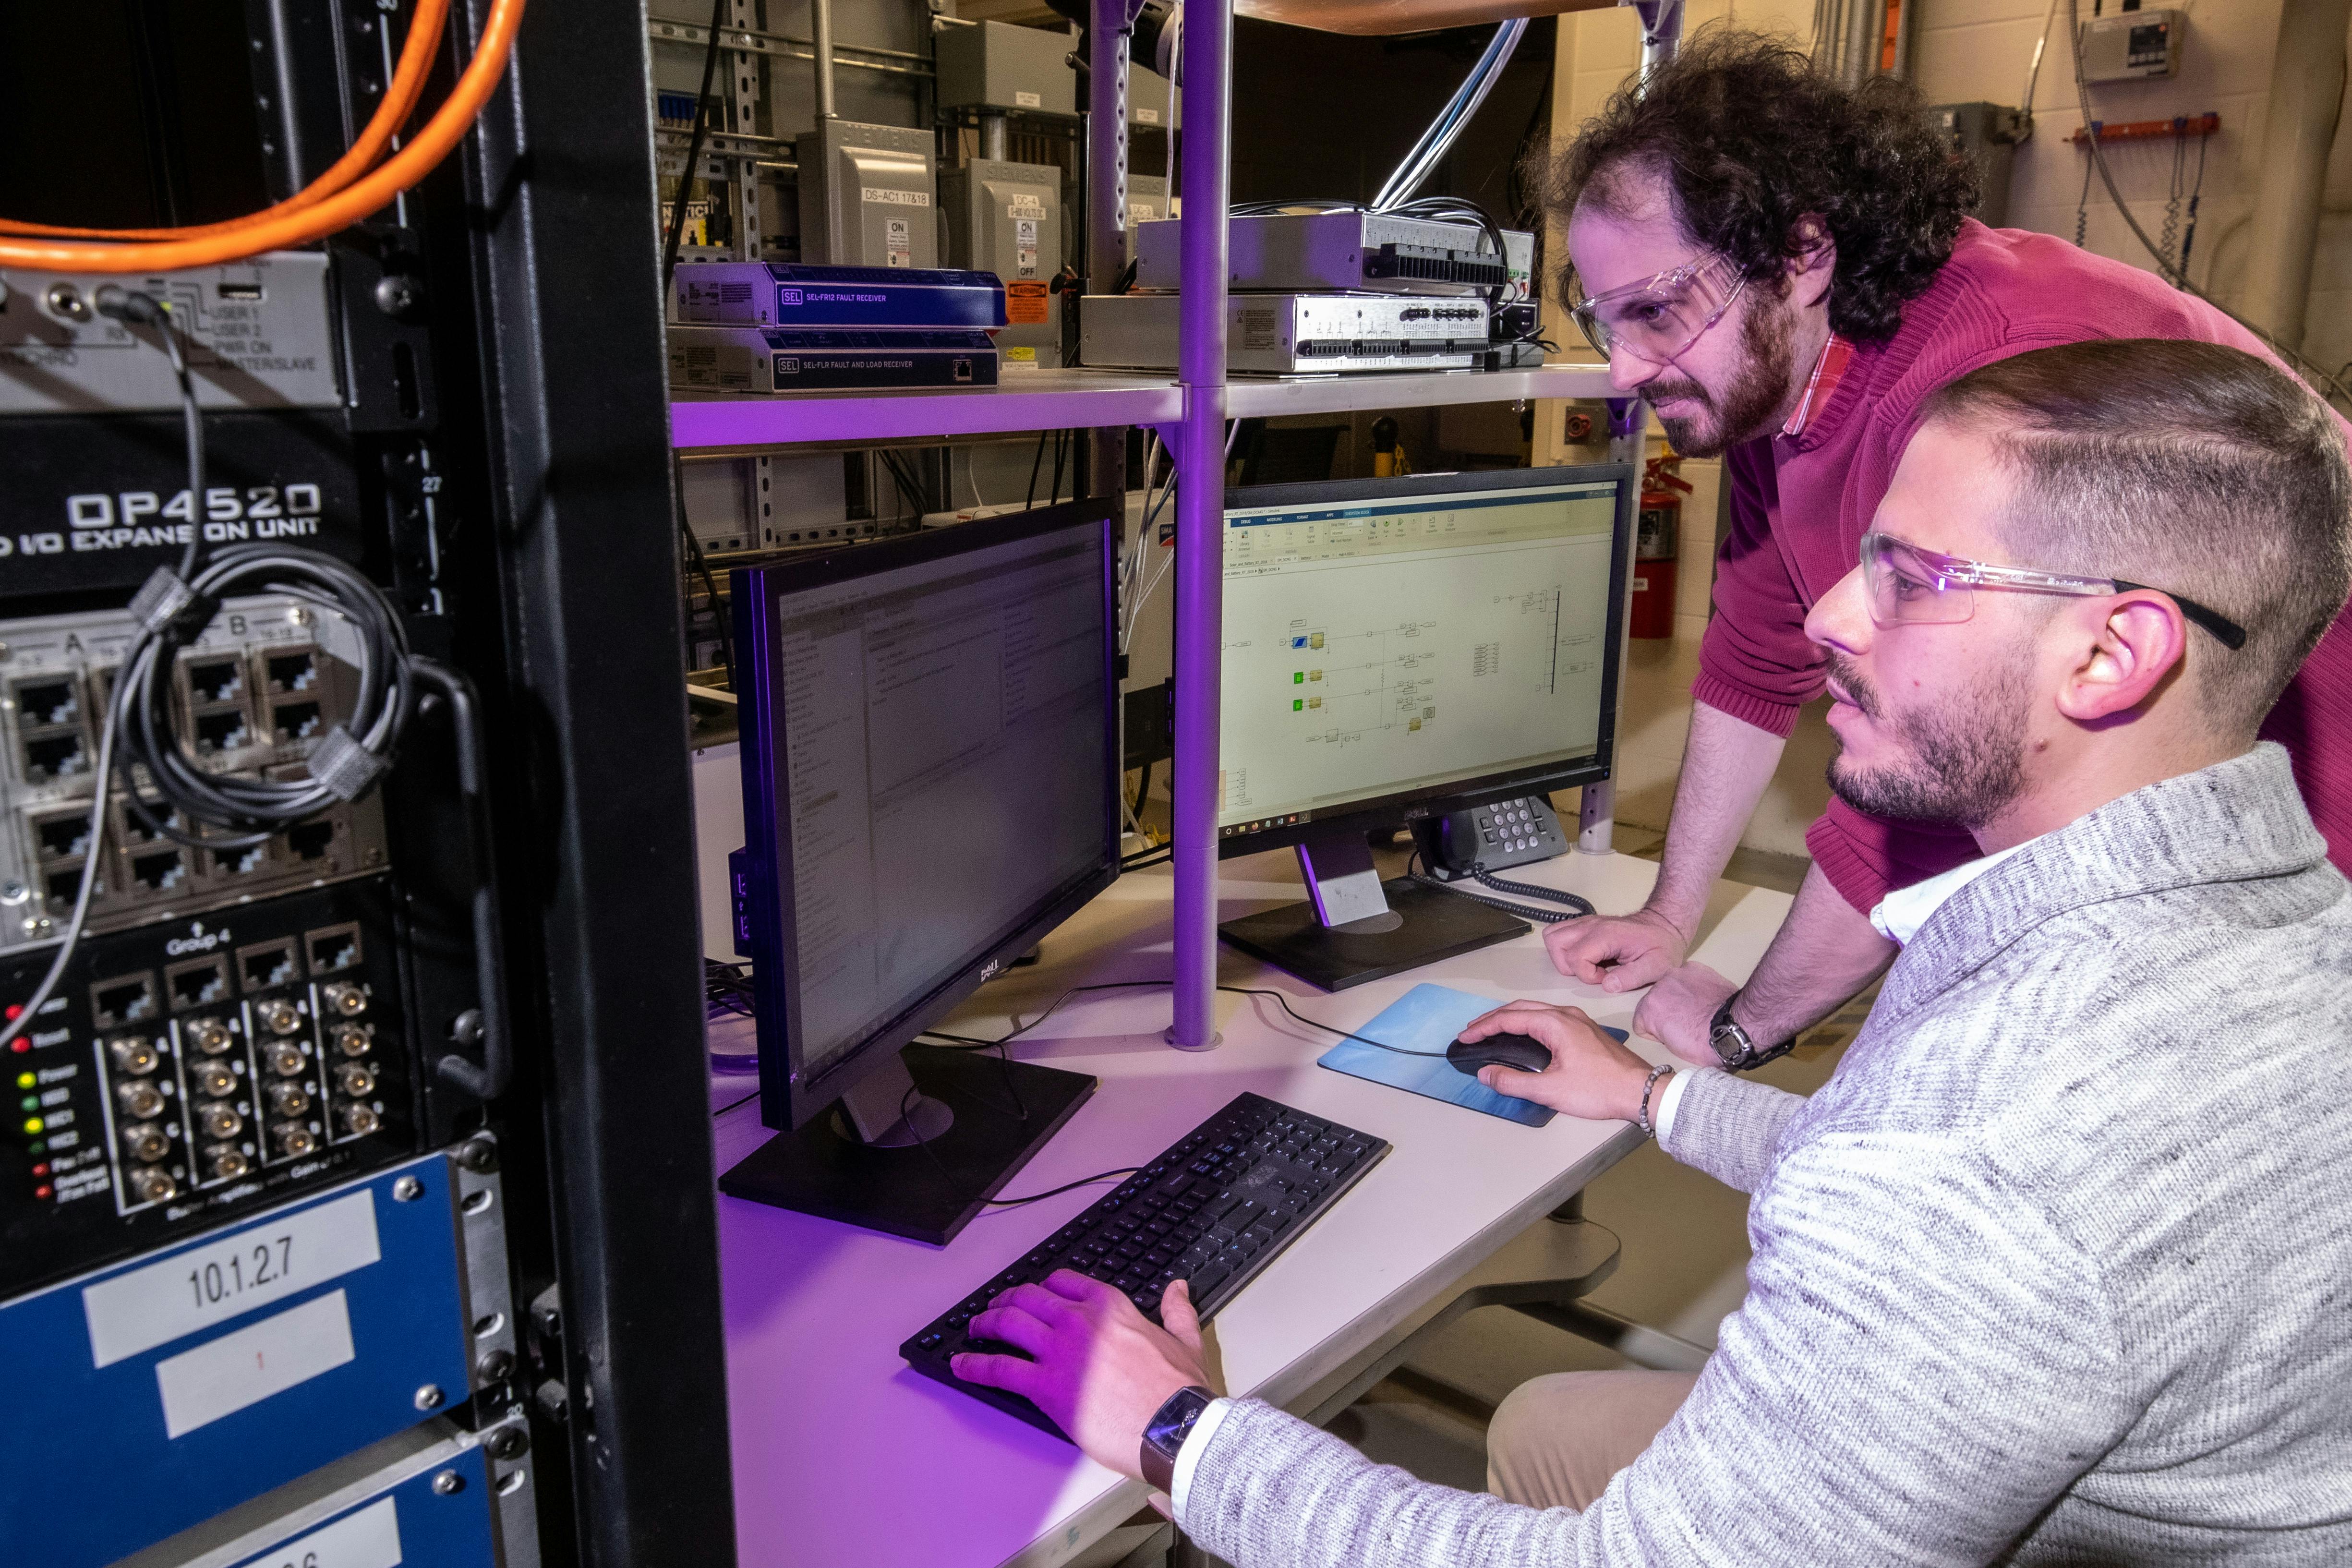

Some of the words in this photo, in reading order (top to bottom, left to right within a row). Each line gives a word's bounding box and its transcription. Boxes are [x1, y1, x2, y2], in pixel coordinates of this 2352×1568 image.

[865, 190, 900, 202] DS-AC1
[903, 193, 927, 205] 17&18
[1017, 195, 1037, 205] DC-4
[891, 222, 904, 232] ON
[1021, 223, 1032, 232] ON
[1020, 267, 1034, 276] OFF
[784, 292, 801, 302] SEL
[211, 307, 247, 320] USER
[212, 323, 248, 337] USER
[253, 324, 262, 336] 2
[215, 341, 246, 355] PWR
[249, 340, 271, 354] ON
[781, 361, 797, 371] SEL
[422, 476, 443, 493] 27
[67, 483, 321, 529] OP4520
[71, 520, 249, 552] EXPANSON
[255, 516, 321, 538] UNIT
[230, 616, 248, 636] B
[64, 634, 84, 654] A
[166, 934, 218, 956] Group
[218, 927, 231, 943] 4
[981, 959, 999, 982] DELL
[189, 1235, 293, 1307] 10.1.2.7
[507, 1403, 524, 1417] 20
